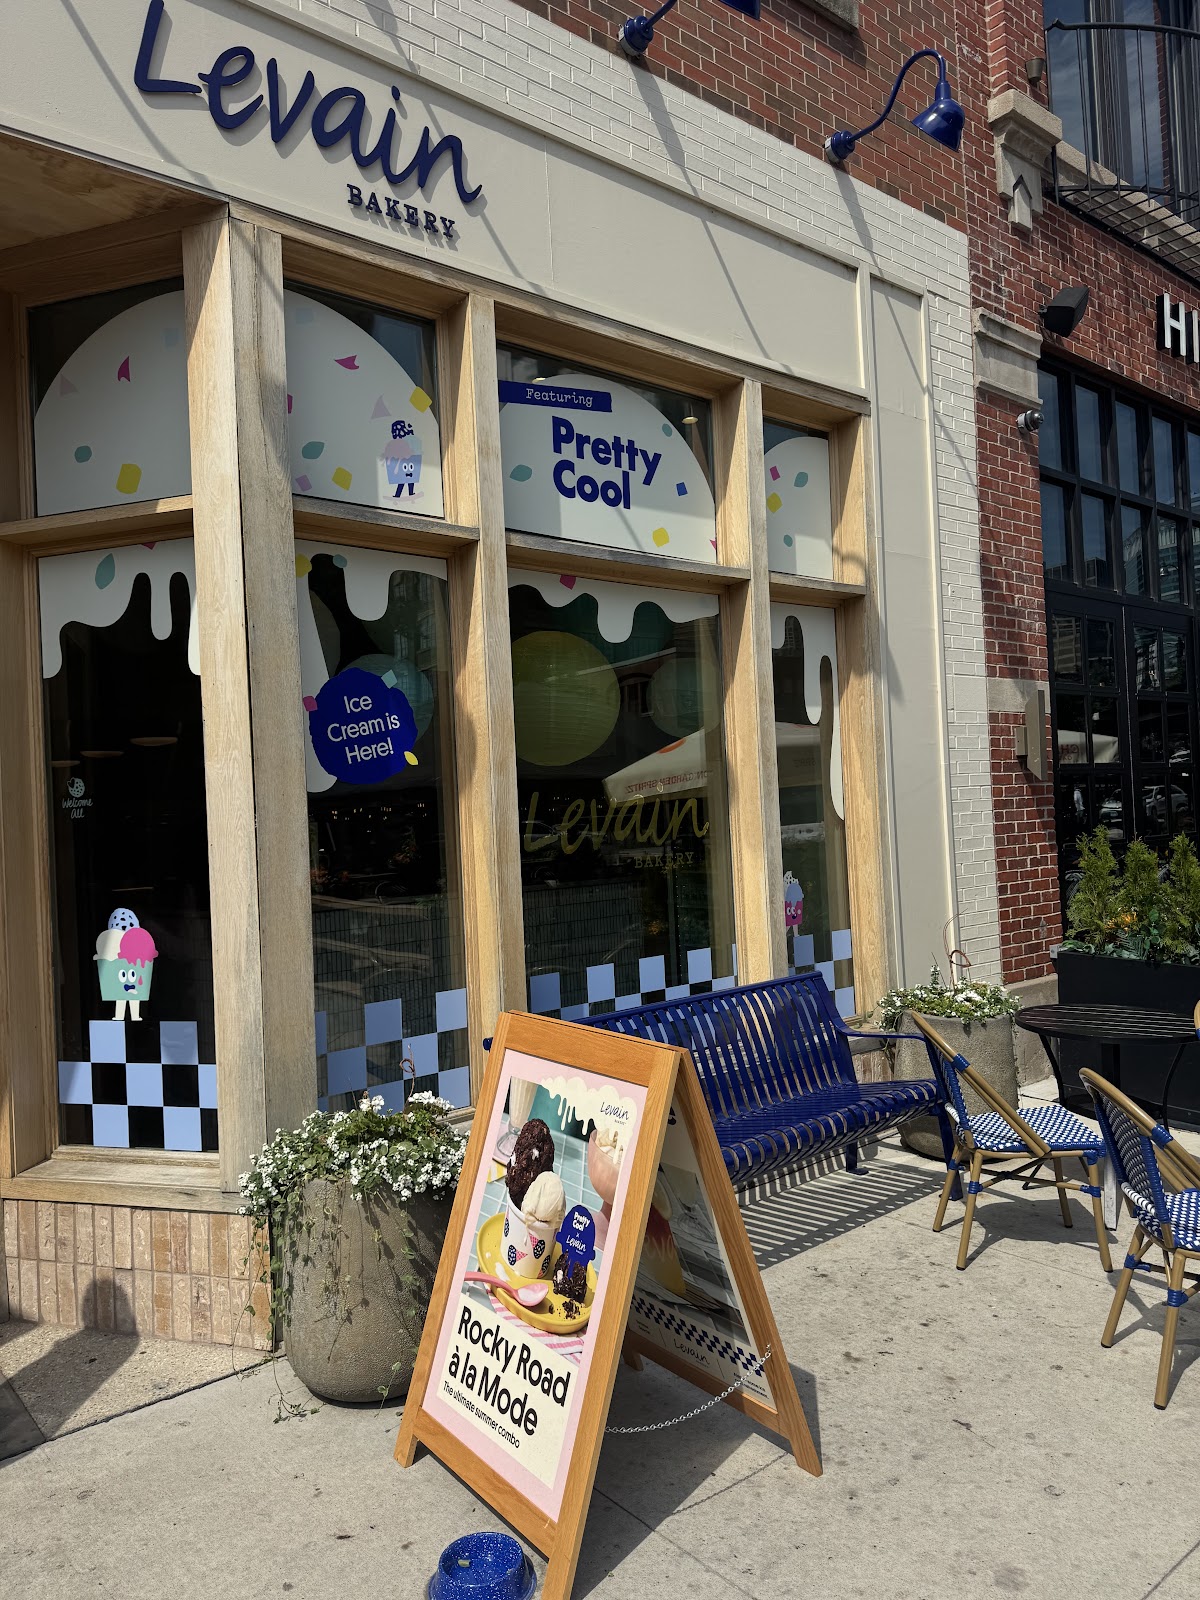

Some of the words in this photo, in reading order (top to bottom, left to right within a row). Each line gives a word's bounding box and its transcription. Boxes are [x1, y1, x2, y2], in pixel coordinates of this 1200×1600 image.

[134, 0, 483, 204] Levain
[346, 183, 456, 240] BAKERY
[525, 387, 594, 408] Featuring
[551, 415, 663, 487] Pretty
[552, 459, 631, 510] Cool
[343, 695, 373, 714] Ice
[326, 717, 386, 742] Cream
[385, 712, 401, 731] is
[344, 736, 395, 765] Here!
[61, 797, 94, 809] Welcome
[523, 783, 710, 855] Levain
[633, 851, 695, 869] BAKERY
[600, 1101, 629, 1120] Levain
[572, 1219, 584, 1231] Cool
[573, 1211, 591, 1228] Pretty
[566, 1234, 586, 1252] Levain
[457, 1305, 517, 1374] Rocky
[515, 1343, 571, 1408] Road
[673, 1338, 710, 1365] Levain
[448, 1345, 460, 1379] à
[460, 1352, 477, 1391] la
[477, 1366, 538, 1436] Mode
[443, 1380, 454, 1396] The
[453, 1389, 476, 1413] ultimate
[474, 1407, 499, 1431] summer
[497, 1425, 520, 1449] combo
